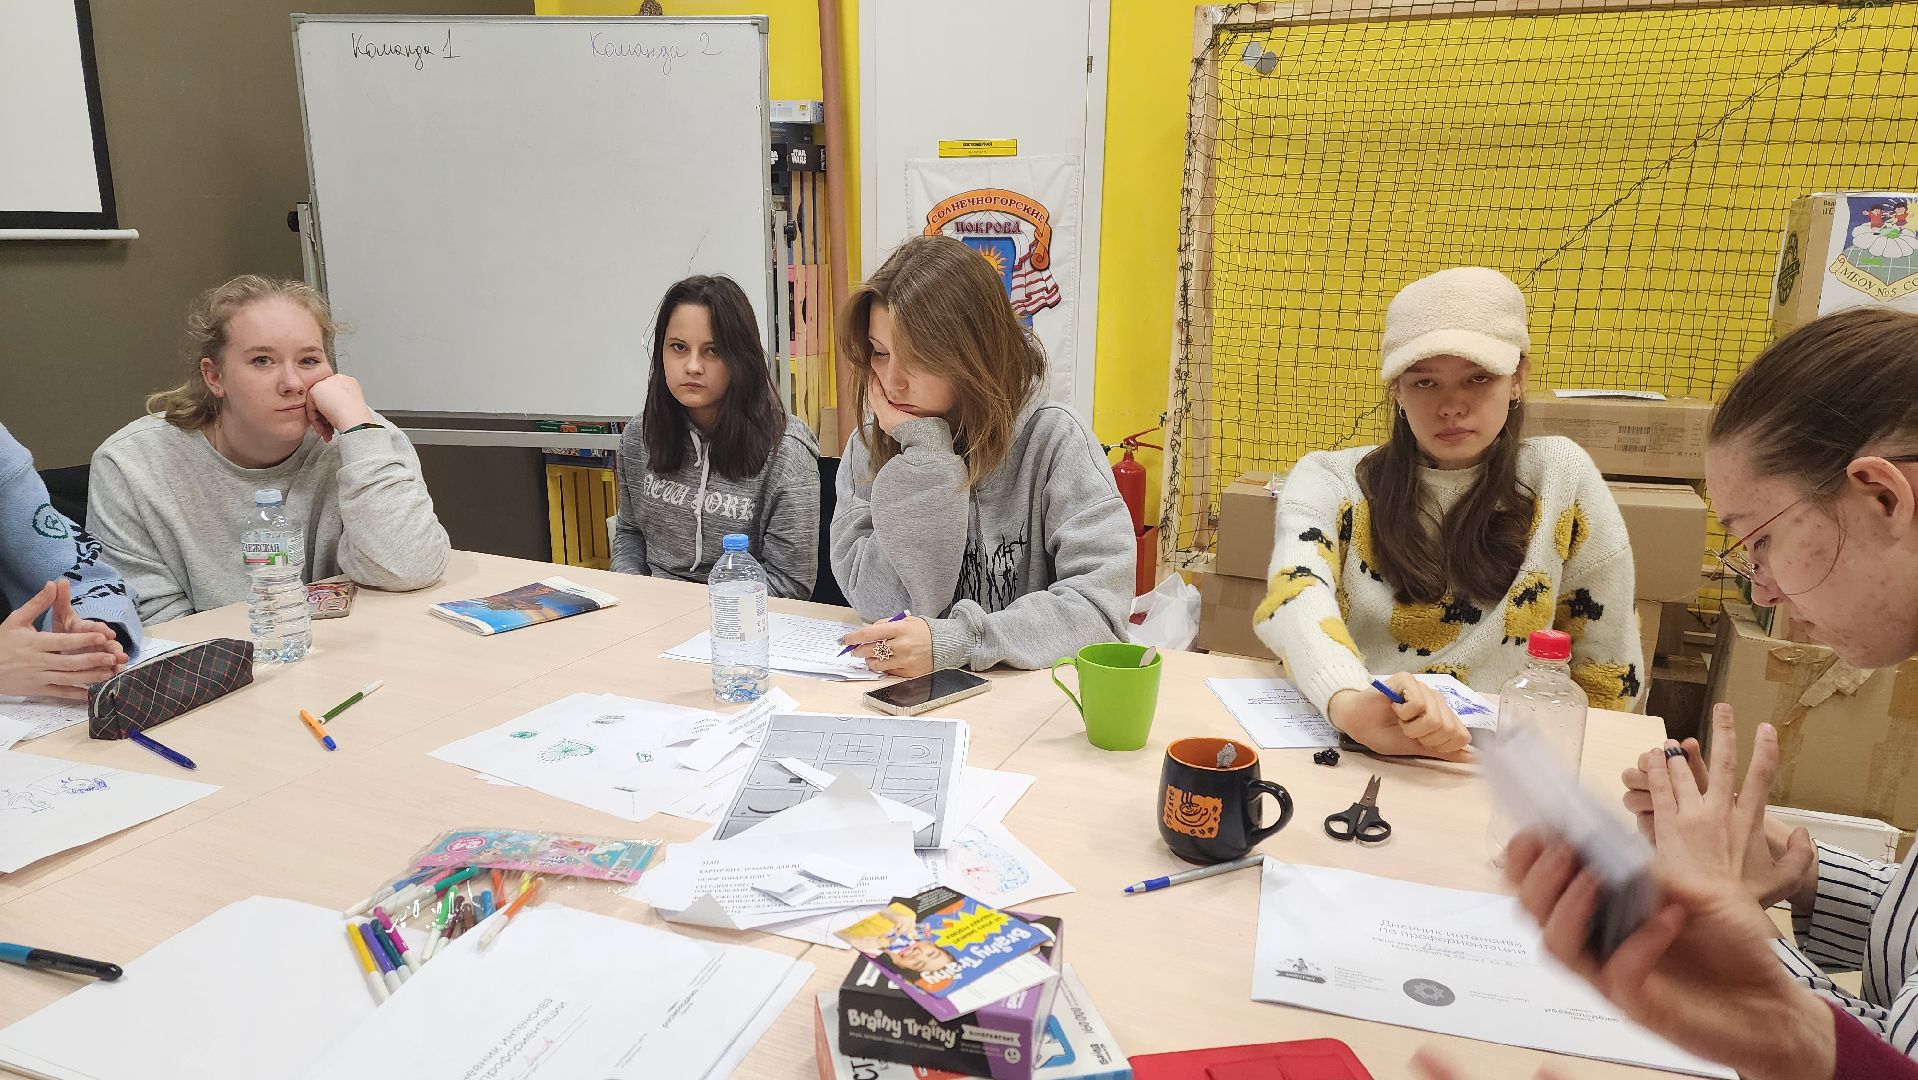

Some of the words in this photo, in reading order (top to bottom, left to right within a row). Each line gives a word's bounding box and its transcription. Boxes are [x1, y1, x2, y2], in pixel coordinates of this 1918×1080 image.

[351, 32, 435, 71] Команда
[442, 28, 461, 59] 1
[589, 31, 688, 76] Команда
[699, 31, 722, 56] 2
[931, 196, 1045, 224] СОЛНЕЧНОГОРСКИЕ
[954, 221, 1022, 234] ПОКРОВА
[969, 927, 1032, 959] Brainy
[920, 955, 983, 985] Trainy
[847, 1008, 902, 1038] Brainy
[903, 1017, 957, 1049] Trainy
